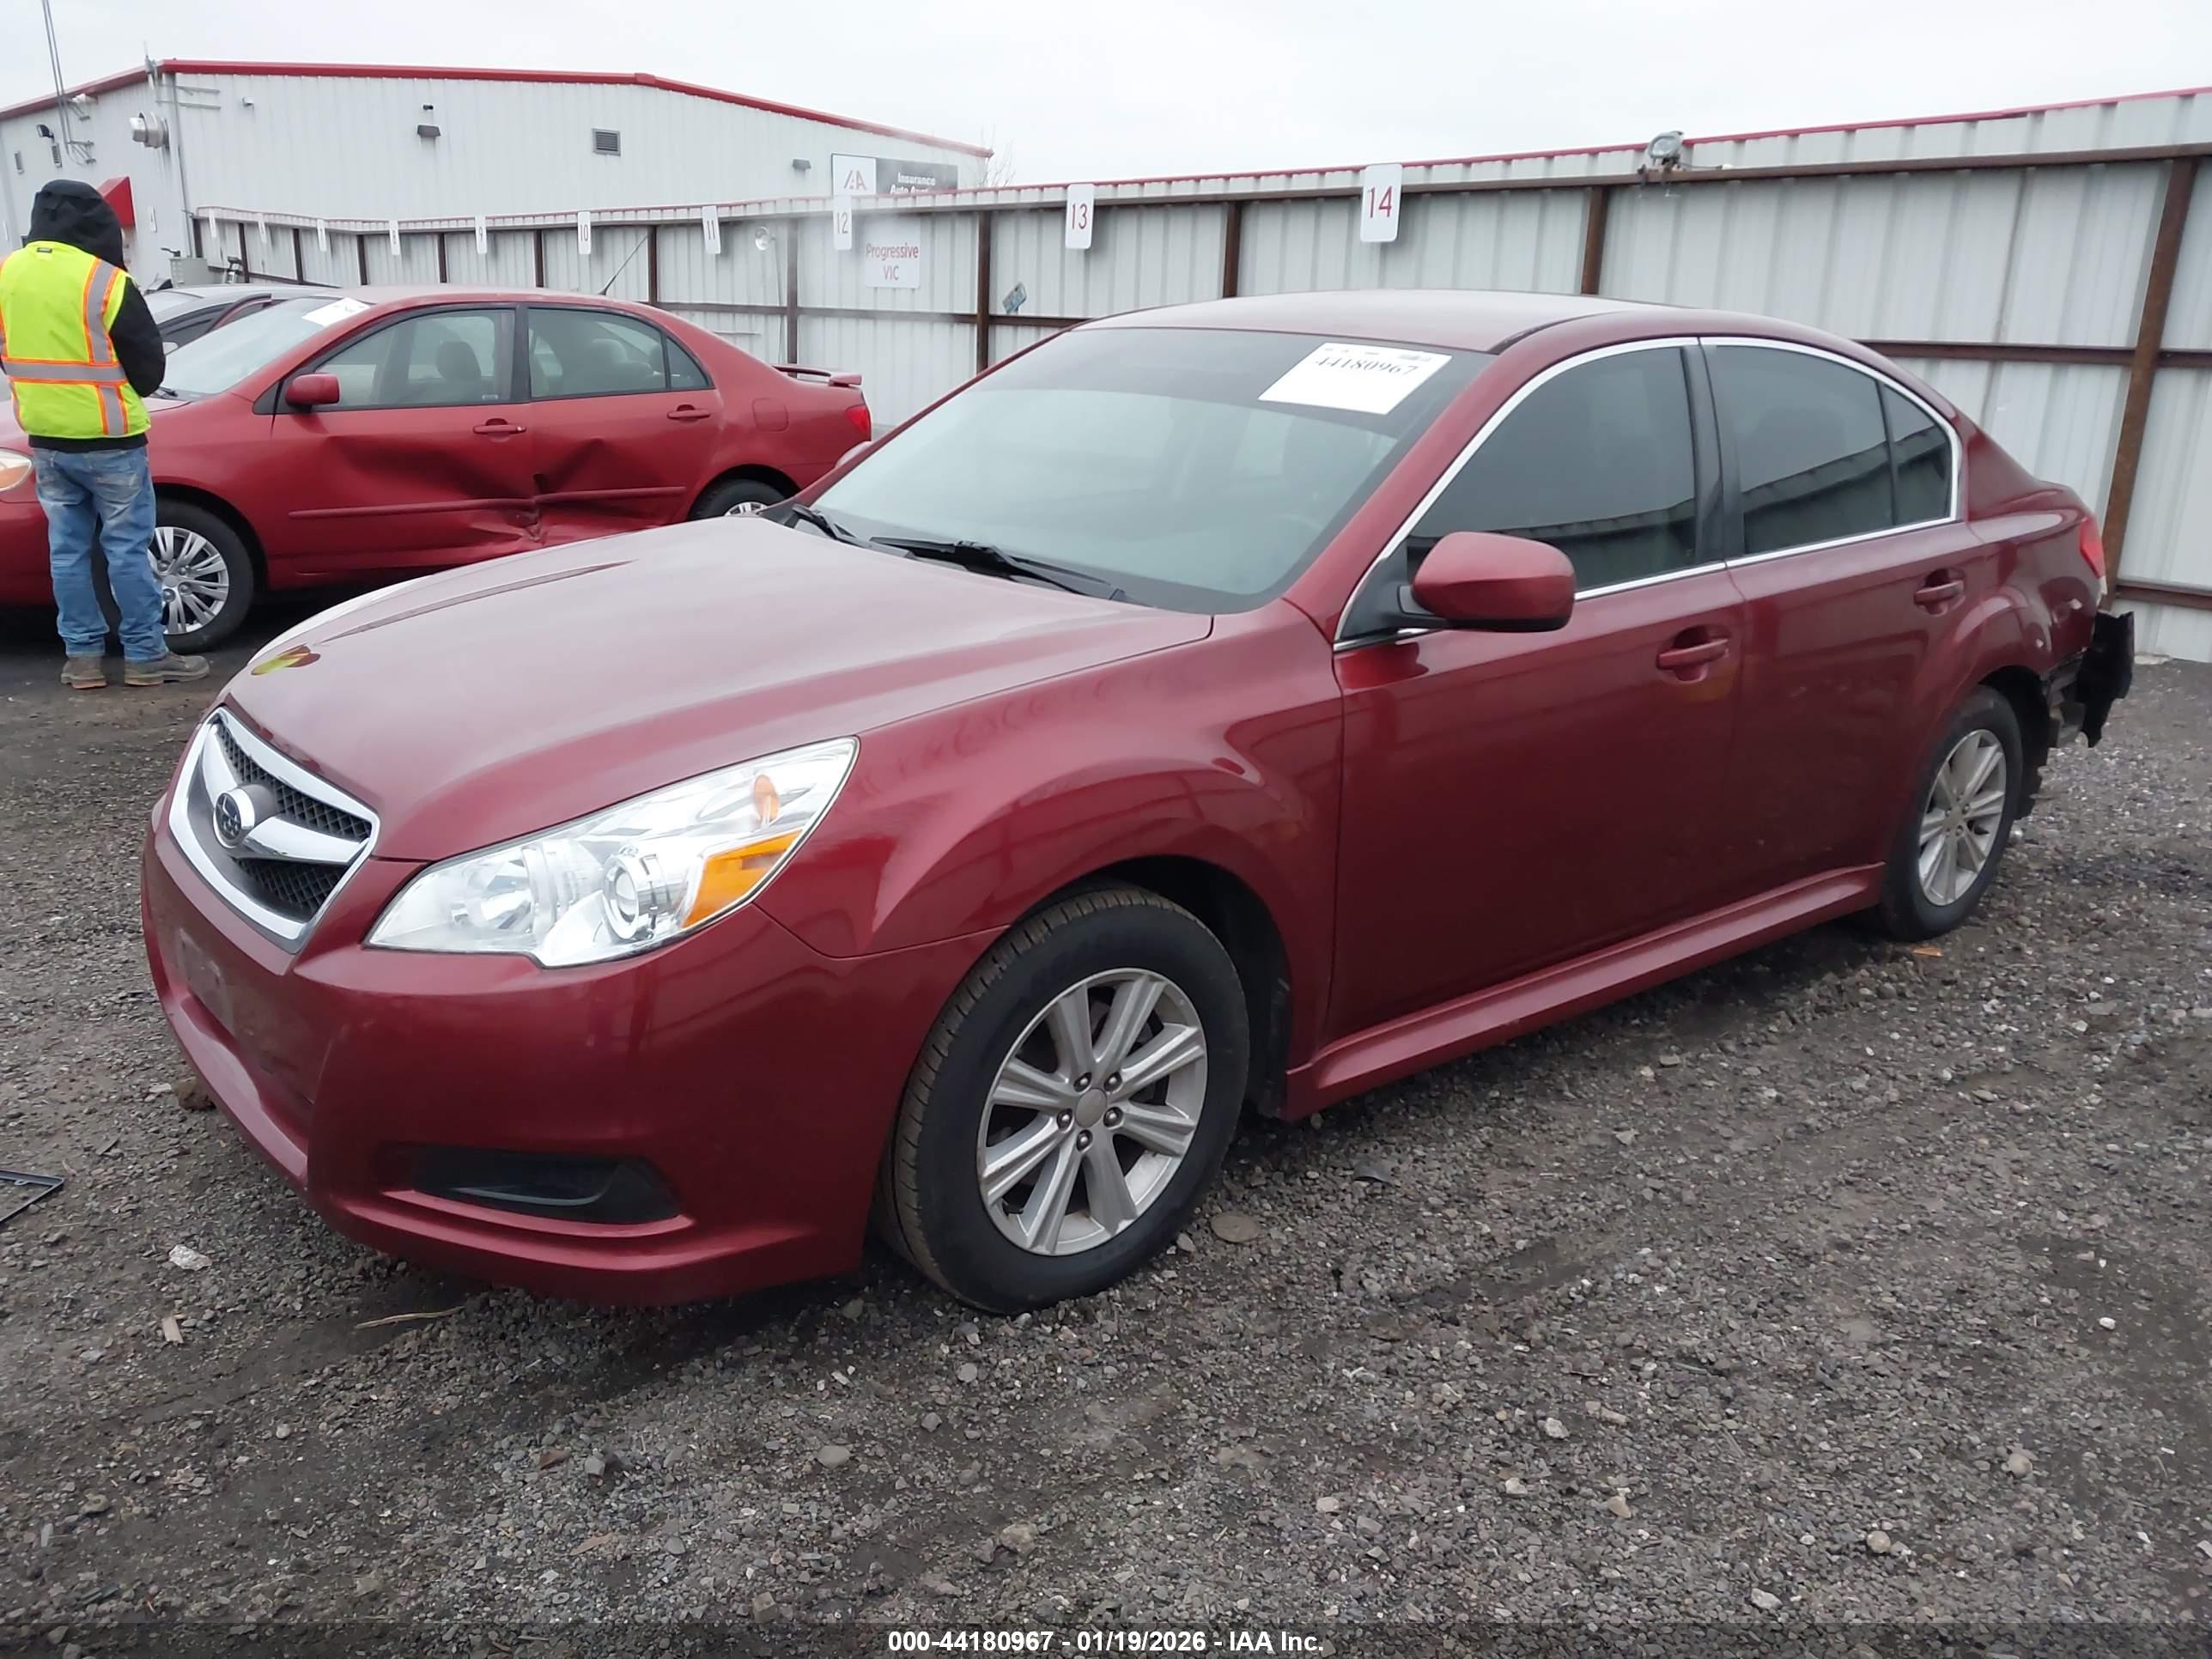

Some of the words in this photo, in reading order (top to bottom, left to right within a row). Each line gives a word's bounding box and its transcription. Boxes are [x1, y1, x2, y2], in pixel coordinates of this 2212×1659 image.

[897, 172, 936, 185] Insurance
[1367, 186, 1393, 218] 14
[836, 212, 849, 234] 12
[1070, 203, 1088, 230] 13
[580, 224, 589, 241] 10
[707, 220, 716, 240] 11
[866, 242, 919, 261] Progressive
[884, 265, 900, 282] VIC
